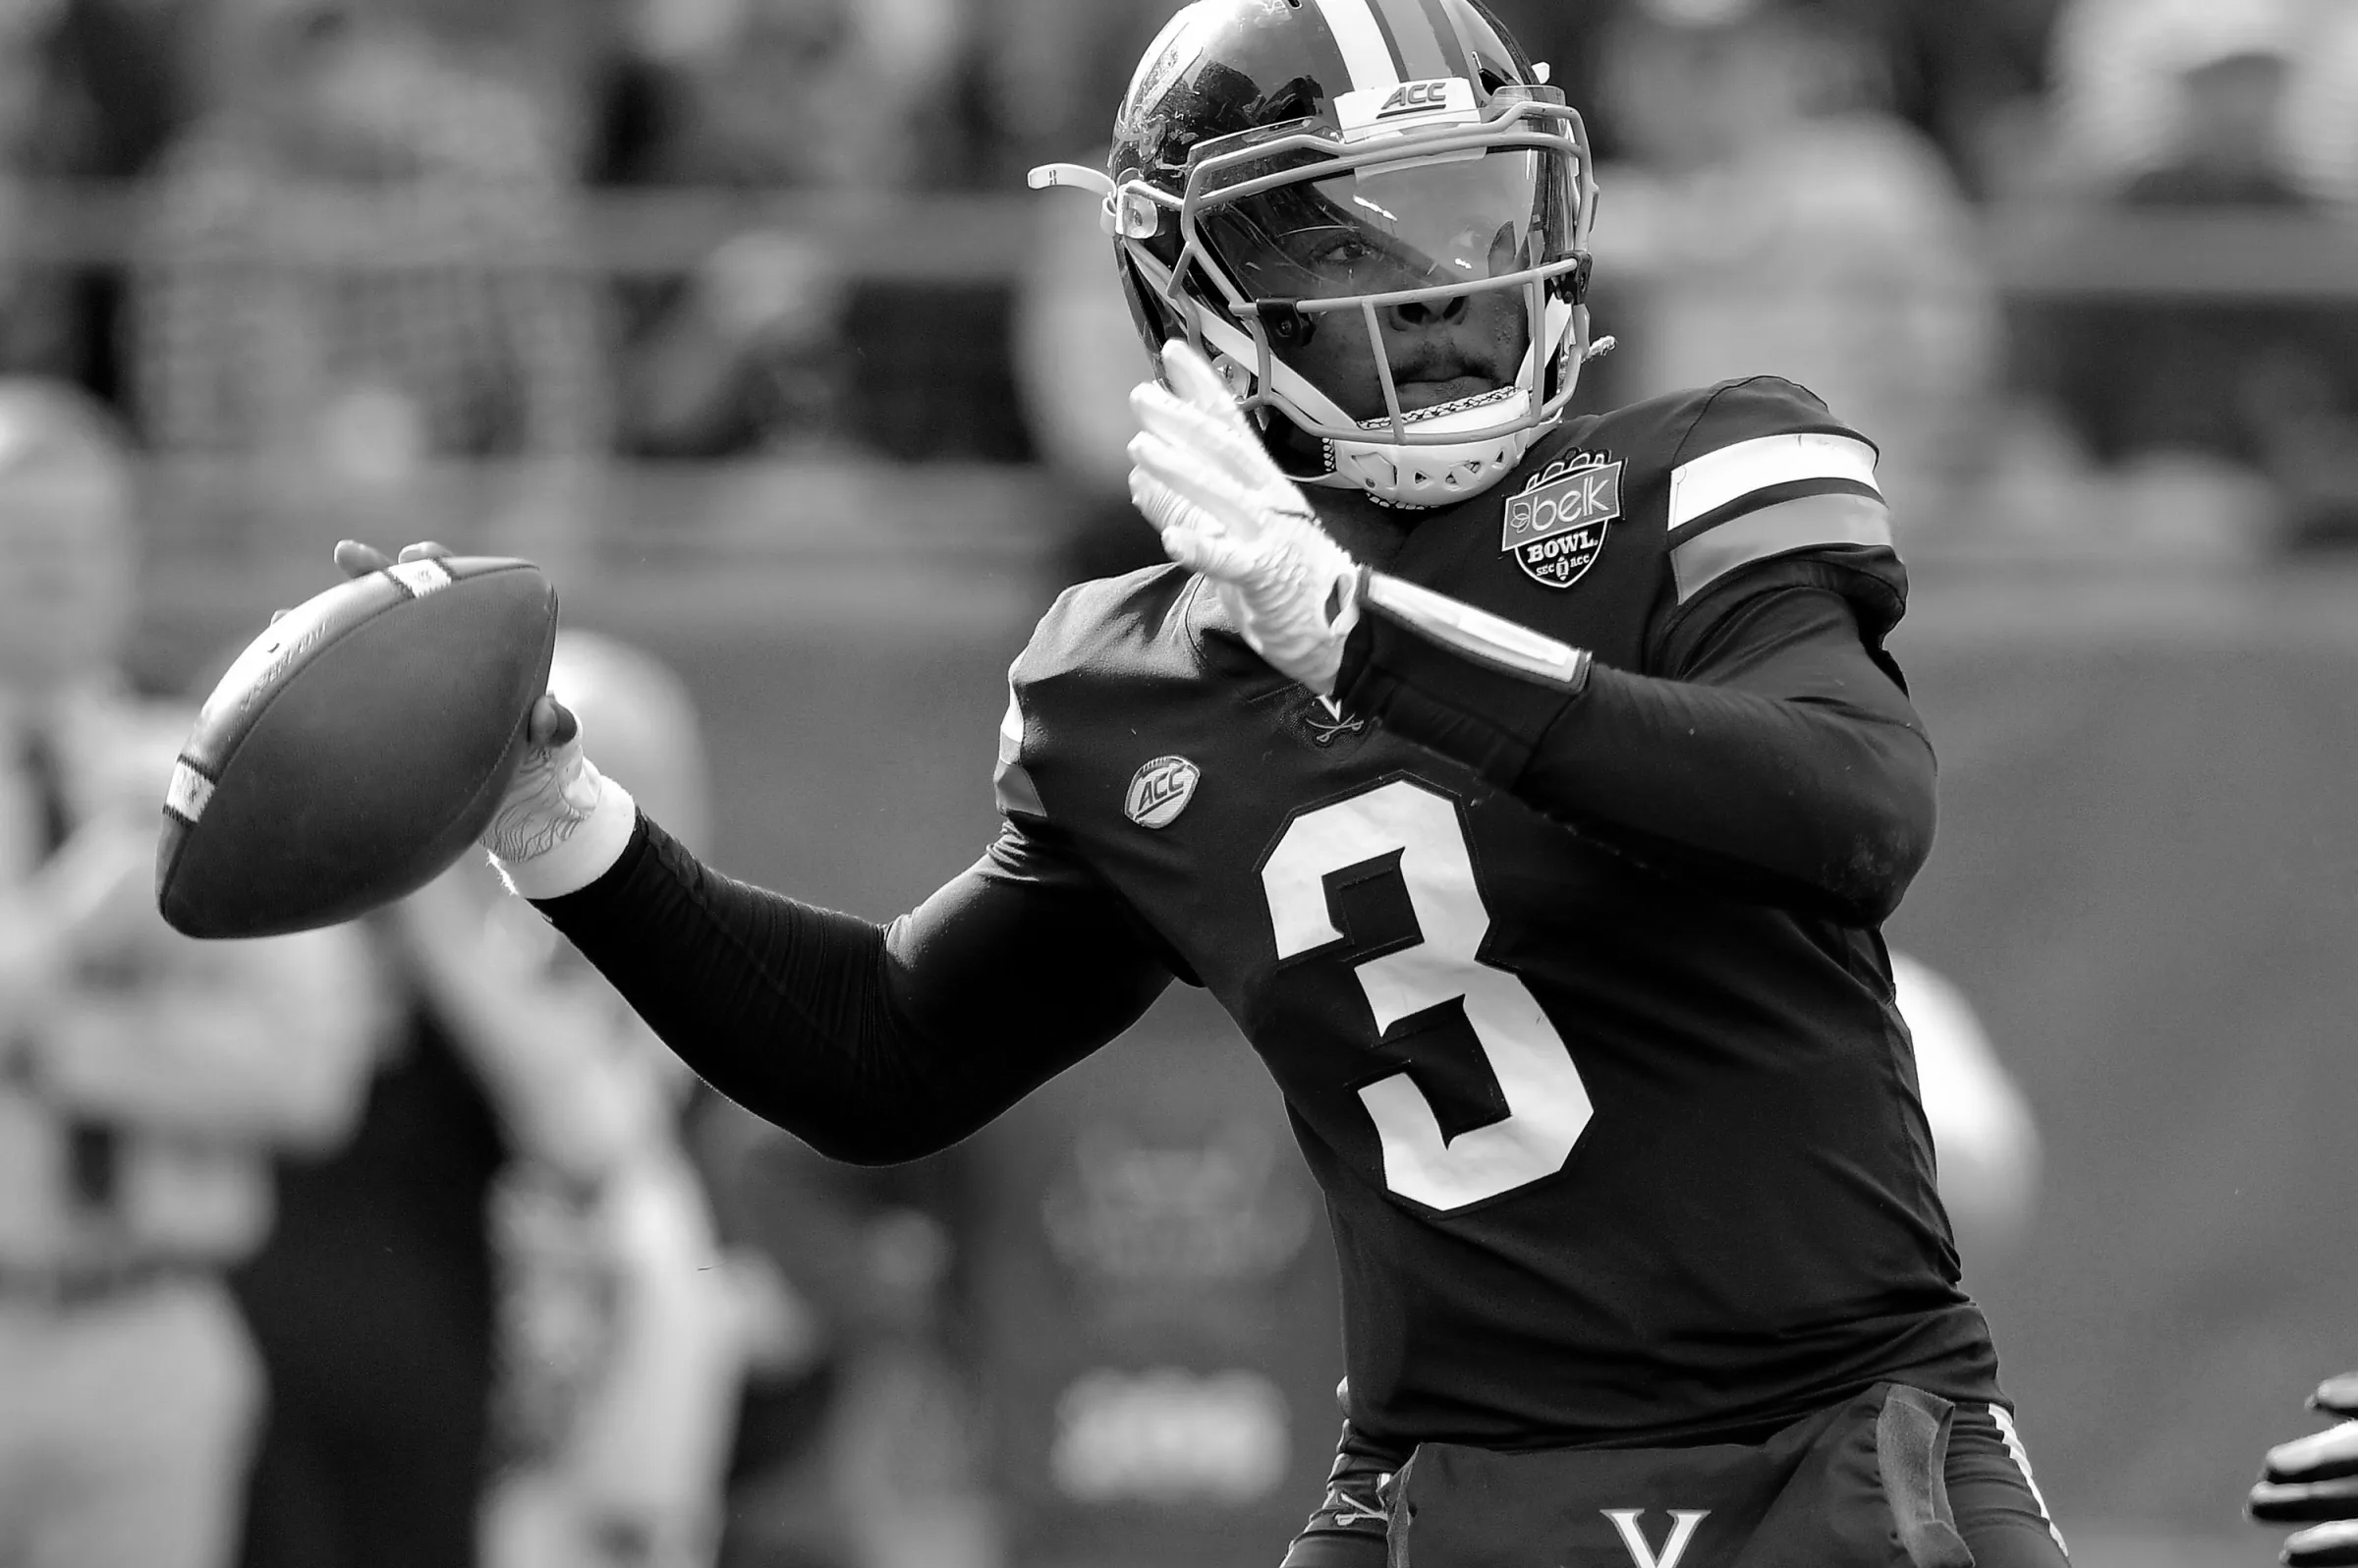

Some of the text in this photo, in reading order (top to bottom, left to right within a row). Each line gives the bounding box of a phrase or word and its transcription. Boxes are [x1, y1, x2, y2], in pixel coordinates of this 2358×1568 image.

[1380, 82, 1446, 110] ACC
[1531, 476, 1610, 532] belk
[1527, 530, 1595, 564] BOWL
[1536, 553, 1590, 577] SEC ACC
[1137, 763, 1187, 812] ACC
[1261, 780, 1595, 1212] 3
[1600, 1507, 1712, 1568] V
